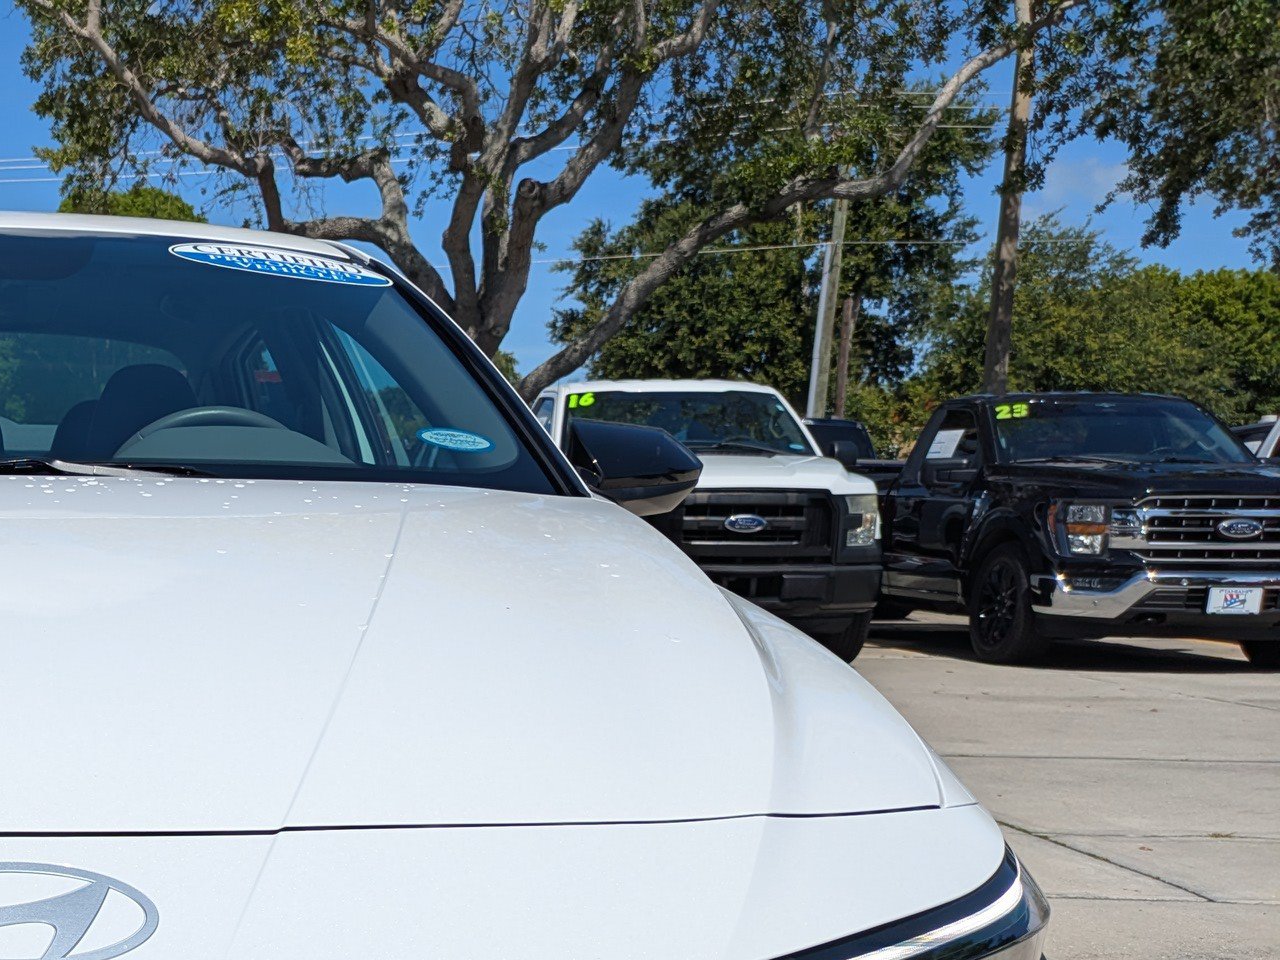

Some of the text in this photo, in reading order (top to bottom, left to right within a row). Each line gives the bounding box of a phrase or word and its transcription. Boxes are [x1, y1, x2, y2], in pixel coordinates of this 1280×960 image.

[192, 245, 363, 274] CERTIFIED
[568, 392, 595, 408] 16
[994, 403, 1028, 420] 23
